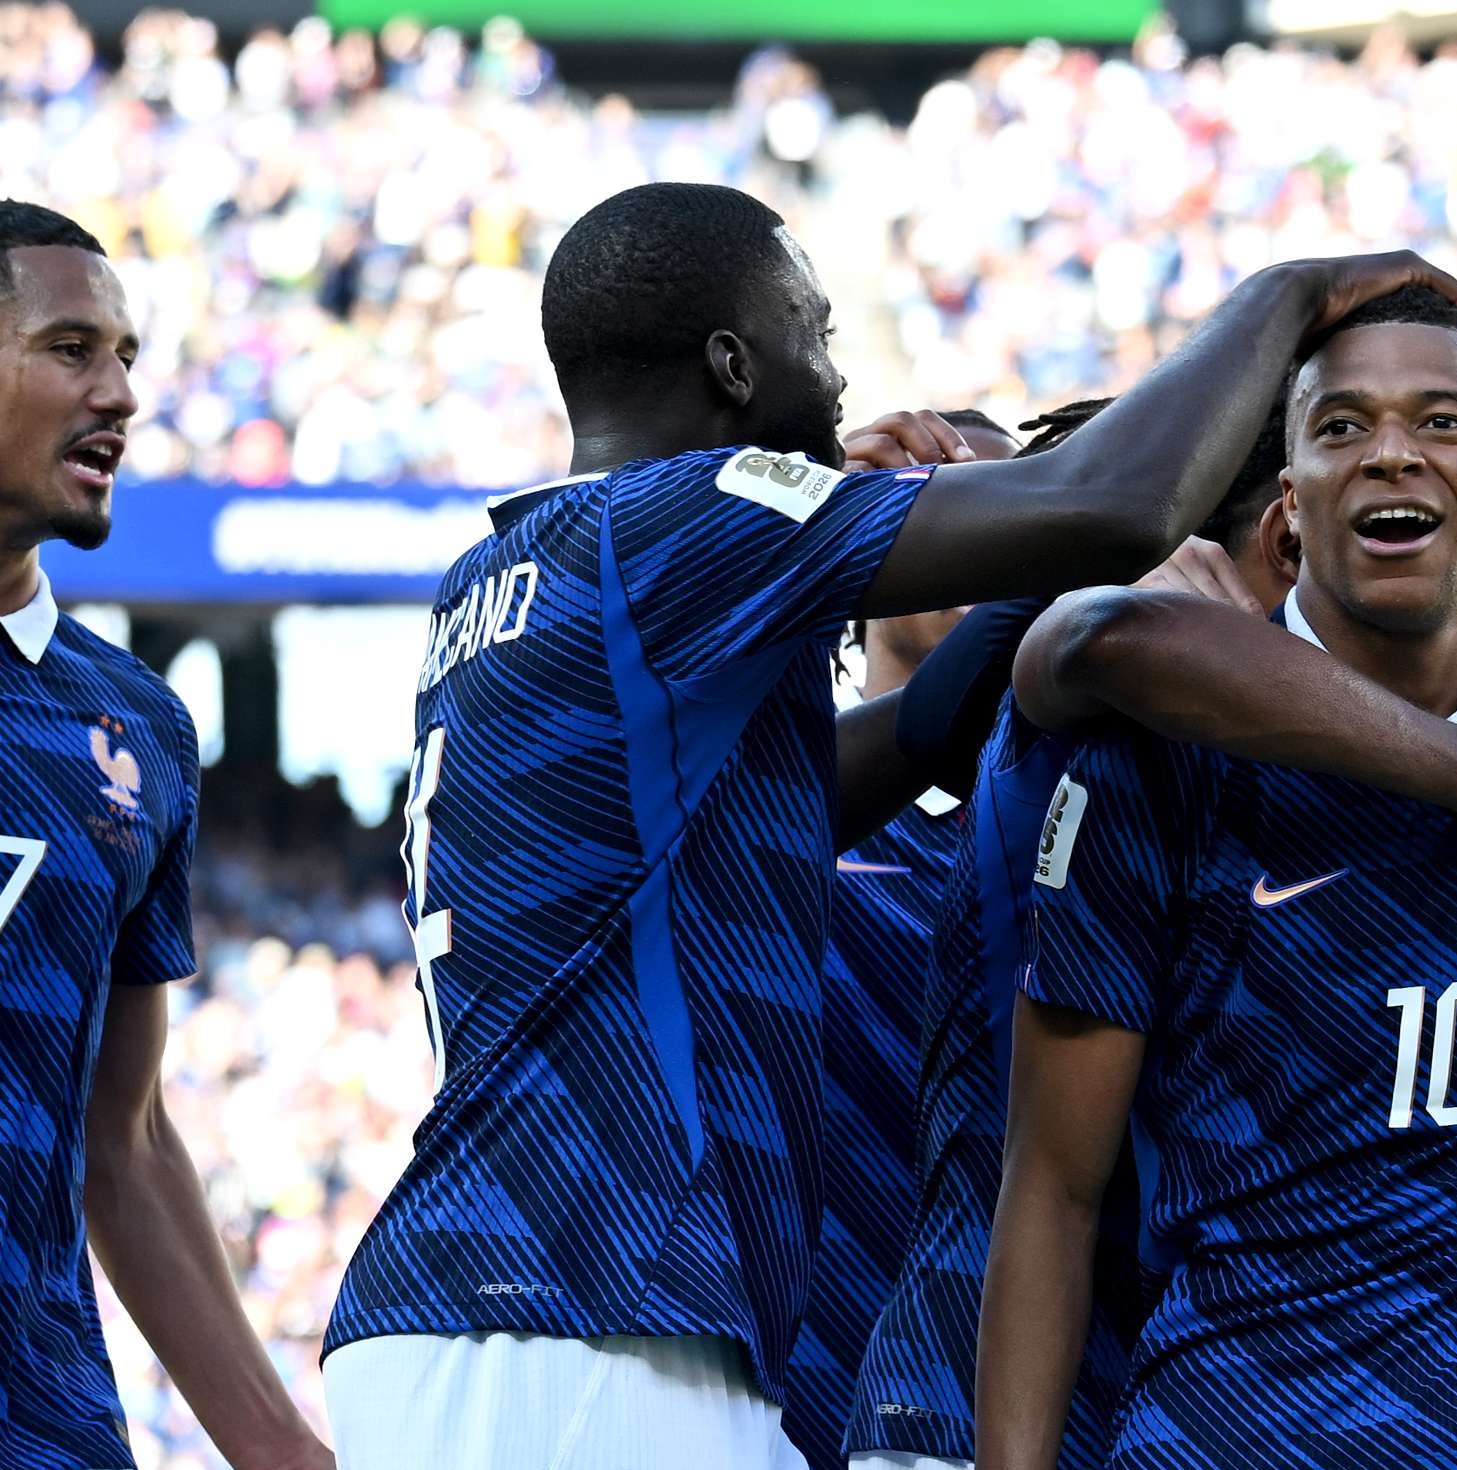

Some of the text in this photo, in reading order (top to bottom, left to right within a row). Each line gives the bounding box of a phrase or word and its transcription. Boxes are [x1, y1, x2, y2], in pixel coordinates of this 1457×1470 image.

[808, 473, 832, 500] 2026
[477, 1284, 564, 1298] AERO-FIT
[876, 1403, 936, 1419] ERO-FIT
